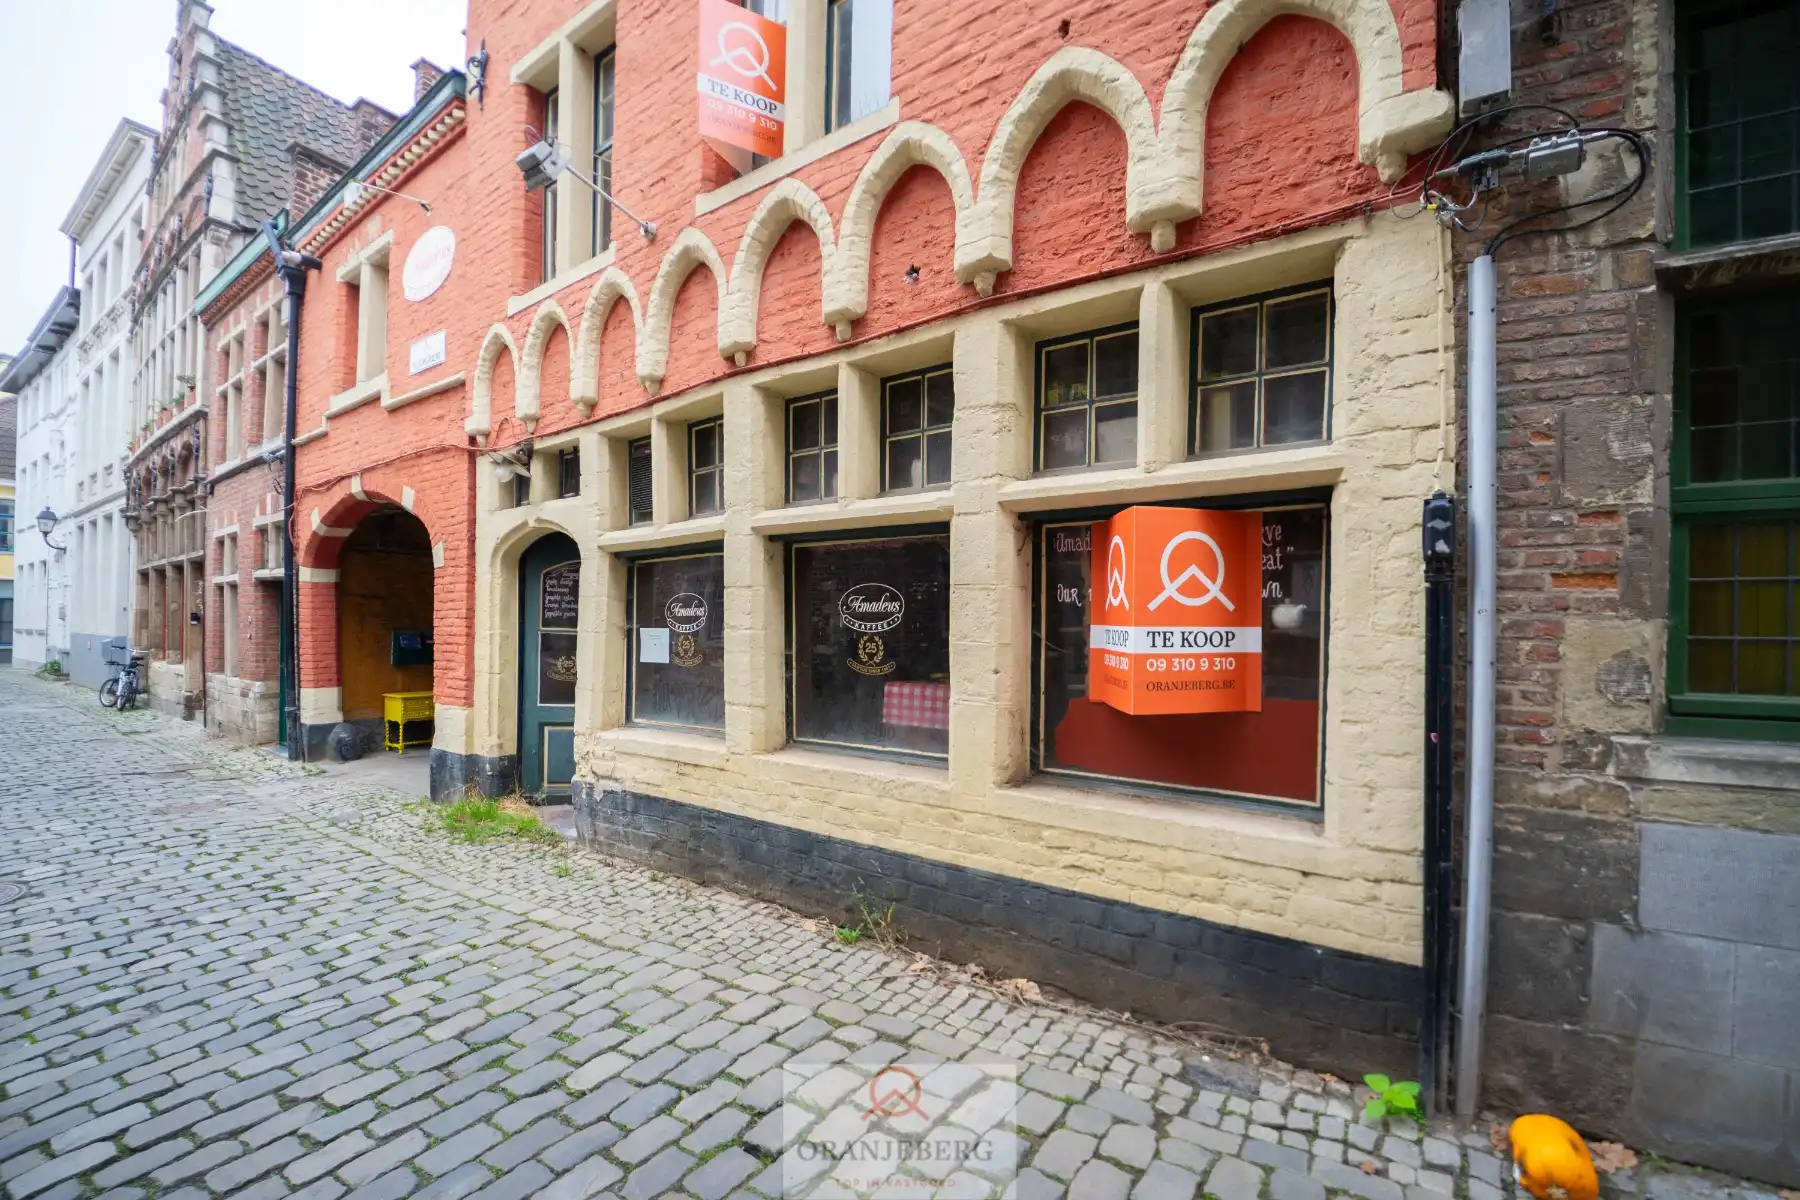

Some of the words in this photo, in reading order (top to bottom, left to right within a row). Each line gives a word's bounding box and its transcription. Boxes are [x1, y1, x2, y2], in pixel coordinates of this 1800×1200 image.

[707, 79, 729, 97] TE
[733, 90, 778, 115] KOOP
[707, 98, 723, 112] 09
[726, 105, 746, 120] 310
[748, 112, 756, 125] 9
[759, 117, 777, 131] 310
[1056, 531, 1092, 552] Amad
[667, 600, 705, 617] Amadeus
[843, 592, 901, 613] Amadeus
[854, 621, 889, 631] KAFFEE
[682, 641, 690, 649] 25
[1112, 630, 1129, 647] KOOP
[1147, 630, 1174, 648] TE
[1180, 630, 1236, 648] KOOP
[865, 643, 877, 653] 25
[563, 660, 574, 668] 25
[1146, 658, 1166, 672] 09
[1171, 658, 1196, 671] 310
[1200, 657, 1208, 671] 9
[1213, 657, 1236, 670] 310
[1146, 679, 1236, 692] ORANJEBERG.BE
